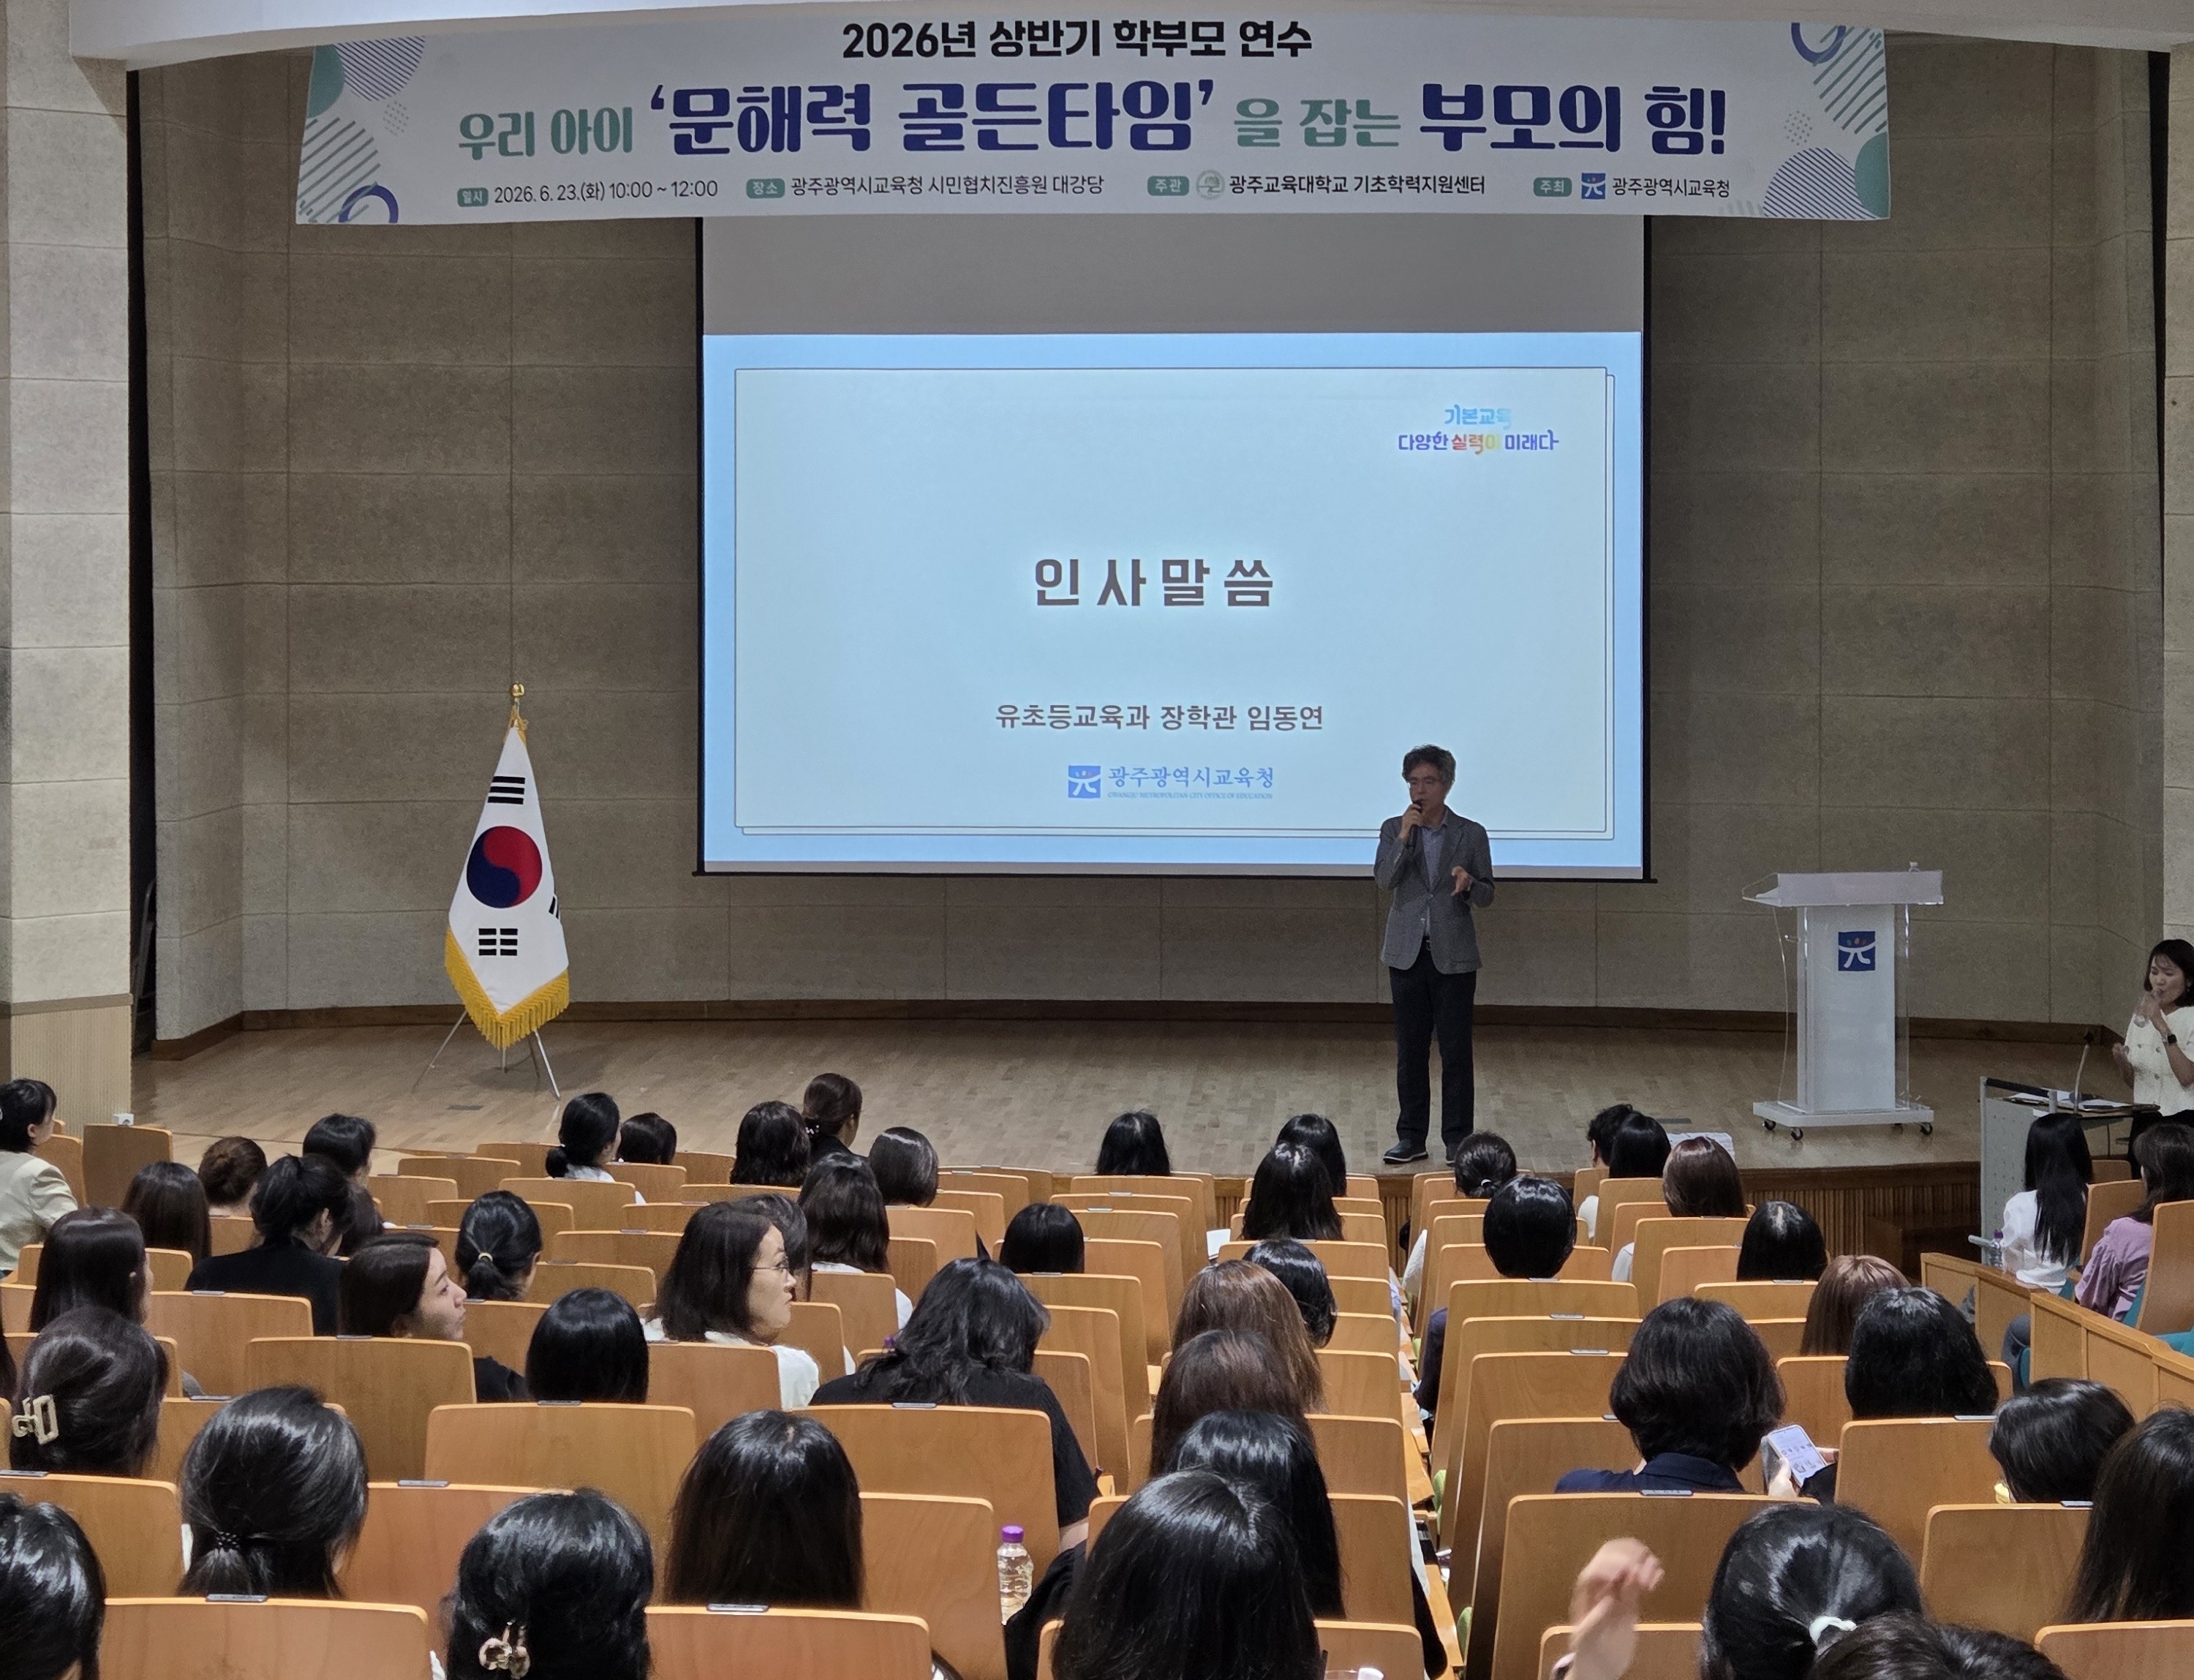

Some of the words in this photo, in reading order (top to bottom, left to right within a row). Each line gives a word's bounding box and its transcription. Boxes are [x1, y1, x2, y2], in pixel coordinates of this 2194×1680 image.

[842, 20, 976, 59] 2026년
[989, 19, 1101, 58] 상반기
[1112, 20, 1226, 58] 학부모
[1239, 20, 1313, 58] 연수
[459, 110, 535, 161] 우리
[550, 106, 633, 156] 아이
[1233, 98, 1283, 148] 을
[1299, 99, 1401, 147] 잡는
[1420, 83, 1621, 153] 부모의
[1644, 86, 1726, 155] 힘!
[753, 181, 778, 195] 장소
[791, 176, 923, 196] 광주광역시교육청
[928, 175, 1048, 195] 시민협치진흥원
[1052, 175, 1105, 195] 대강당
[1155, 178, 1182, 192] 주관
[1229, 175, 1349, 195] 광주교육대학교
[1354, 175, 1485, 195] 기초학력지원센터
[1540, 180, 1564, 194] 주최
[1612, 177, 1730, 198] 광주광역시교육청
[1398, 431, 1449, 451] 다양한
[1452, 433, 1502, 455] 실력이
[1504, 429, 1560, 451] 미래다
[995, 704, 1150, 730] 유초등교육과
[1160, 705, 1237, 731] 장학관
[1248, 705, 1323, 731] 임동연
[1108, 766, 1273, 789] 광주광역시교육청
